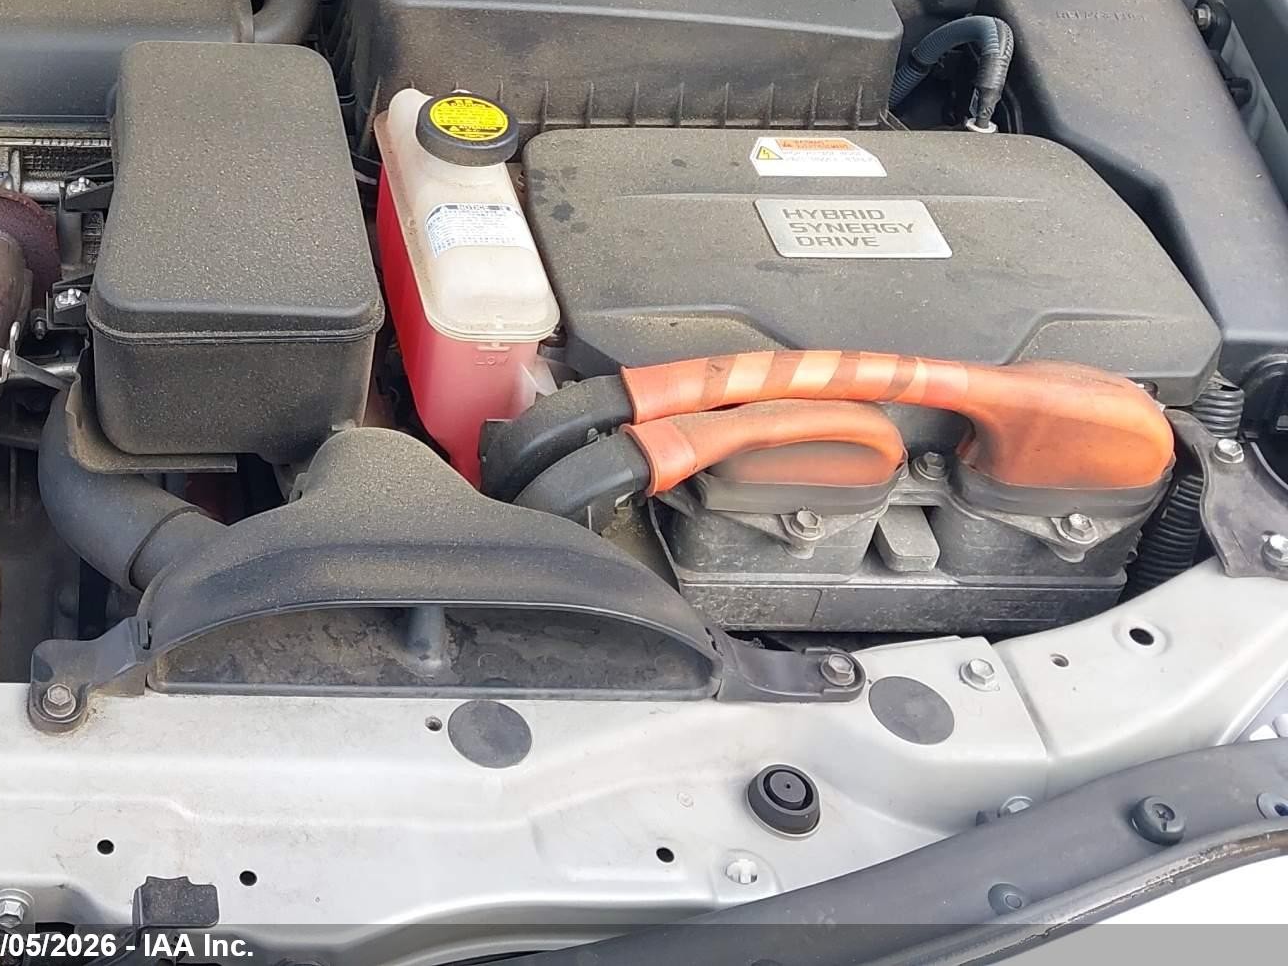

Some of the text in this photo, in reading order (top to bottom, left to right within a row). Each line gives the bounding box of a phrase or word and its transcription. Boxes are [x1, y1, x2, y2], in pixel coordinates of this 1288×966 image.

[782, 208, 886, 220] HYBRID
[789, 222, 915, 234] SYNERGY
[795, 236, 881, 247] DRIVE
